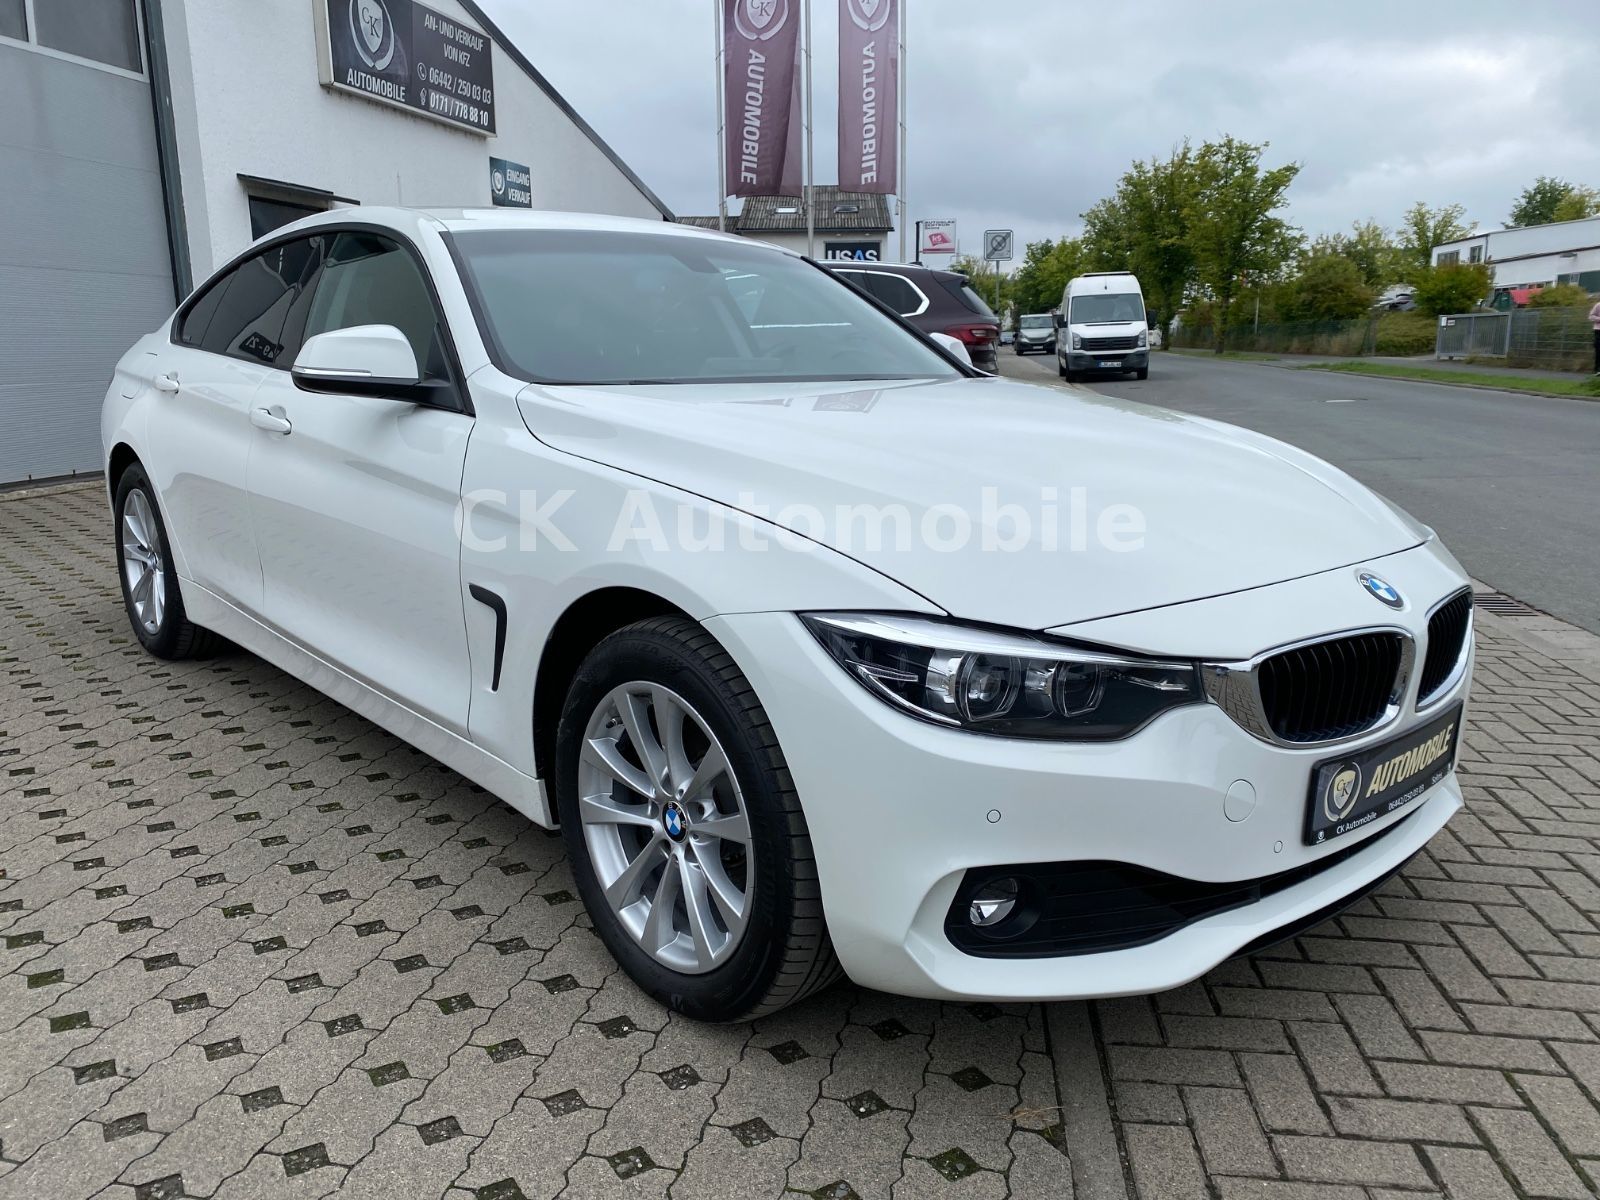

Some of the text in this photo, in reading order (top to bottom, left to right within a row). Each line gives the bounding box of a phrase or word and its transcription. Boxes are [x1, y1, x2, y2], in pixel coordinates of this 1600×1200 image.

[424, 13, 483, 52] AN- UND VERKAUF
[444, 43, 471, 67] VON KFZ
[346, 68, 406, 102] AUTOMOBILE
[429, 67, 452, 90] 06442
[457, 79, 471, 97] 250
[472, 84, 481, 101] 03
[482, 88, 492, 104] 03
[430, 92, 448, 112] 0171
[455, 101, 468, 119] 778
[469, 106, 479, 123] 88
[480, 110, 489, 126] 10
[741, 48, 766, 185] AUTOMOBILE
[861, 41, 877, 185] AUTOMOBILE
[507, 169, 530, 187] EINGANG
[1366, 723, 1454, 798] AUTOMOBILE
[1336, 811, 1378, 834] CK Automobile
